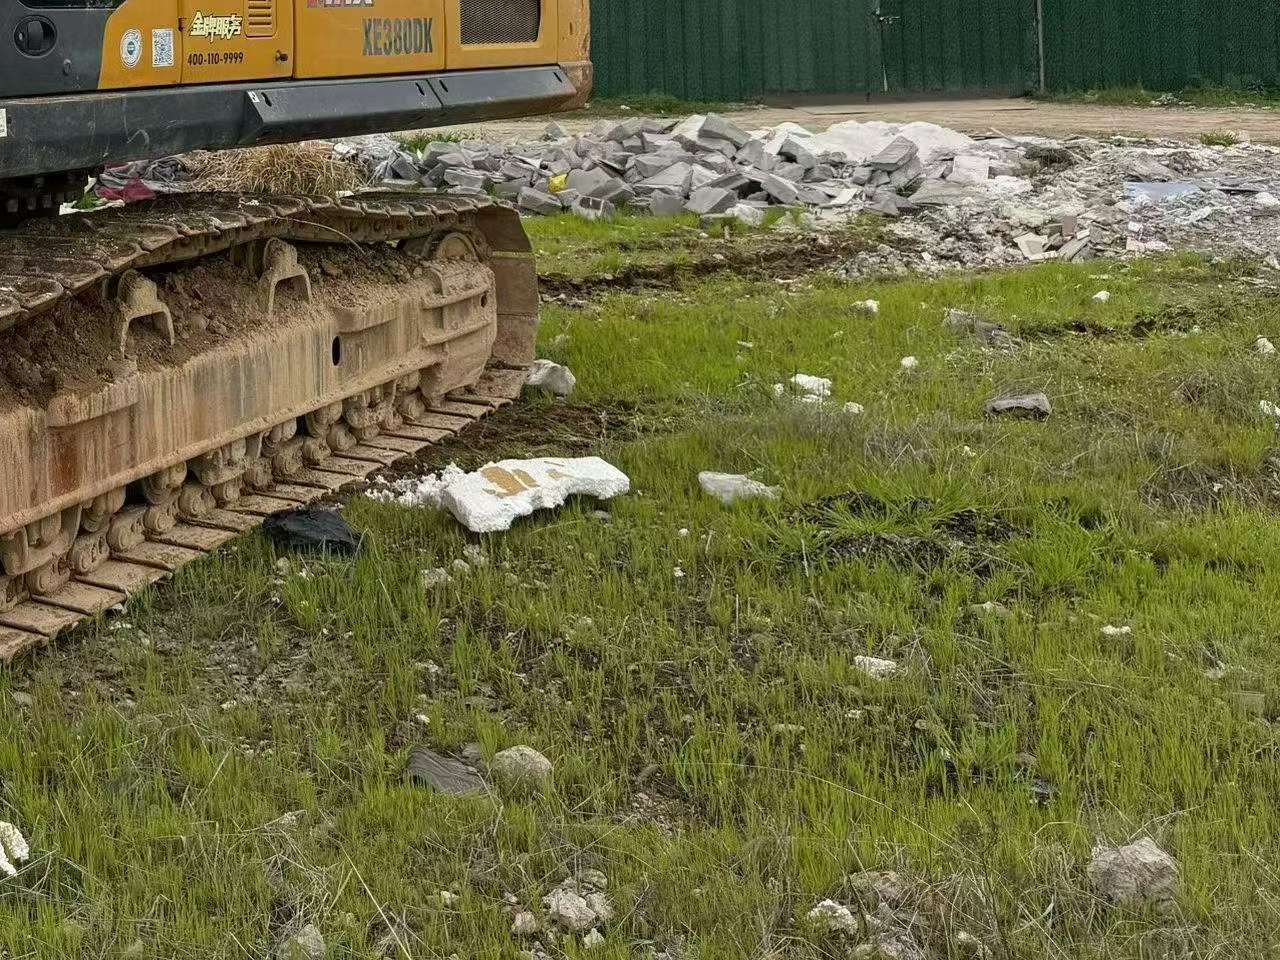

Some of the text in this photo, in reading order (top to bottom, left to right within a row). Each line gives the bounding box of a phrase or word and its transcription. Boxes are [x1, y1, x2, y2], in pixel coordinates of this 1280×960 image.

[189, 10, 243, 43] 金牌服务
[362, 17, 433, 56] XE380DK
[187, 52, 244, 66] 400-110-9999
